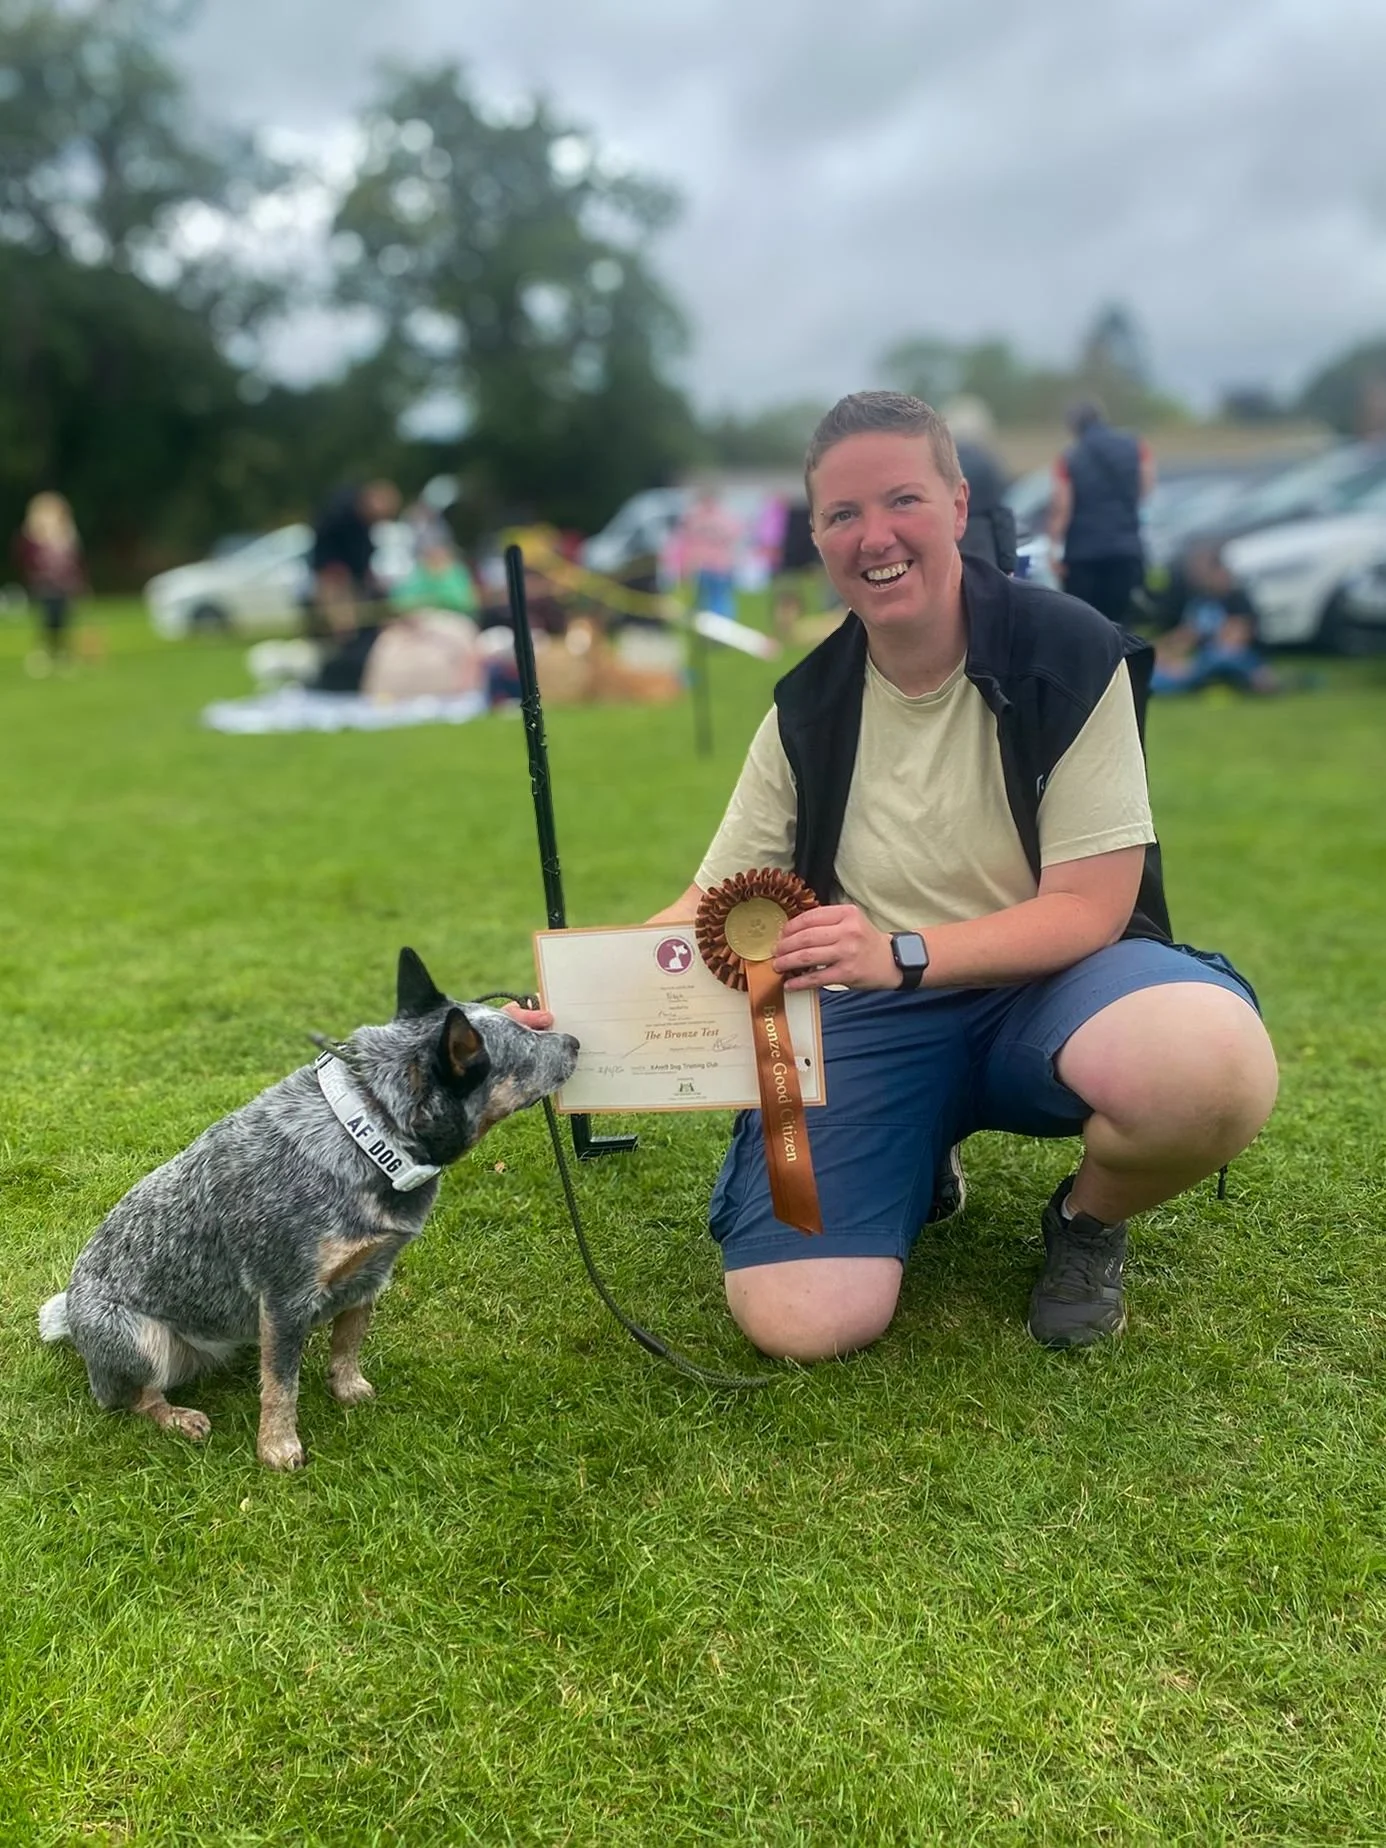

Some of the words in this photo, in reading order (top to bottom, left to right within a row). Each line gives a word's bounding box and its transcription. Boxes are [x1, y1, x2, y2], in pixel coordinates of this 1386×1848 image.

[645, 1030, 661, 1040] The
[664, 1029, 698, 1039] Bronze
[701, 1027, 719, 1037] Test
[763, 1005, 781, 1058] Bronze
[772, 1062, 793, 1104] Good
[346, 1115, 374, 1138] AF
[368, 1139, 402, 1173] DOG
[780, 1107, 798, 1163] Citizen
